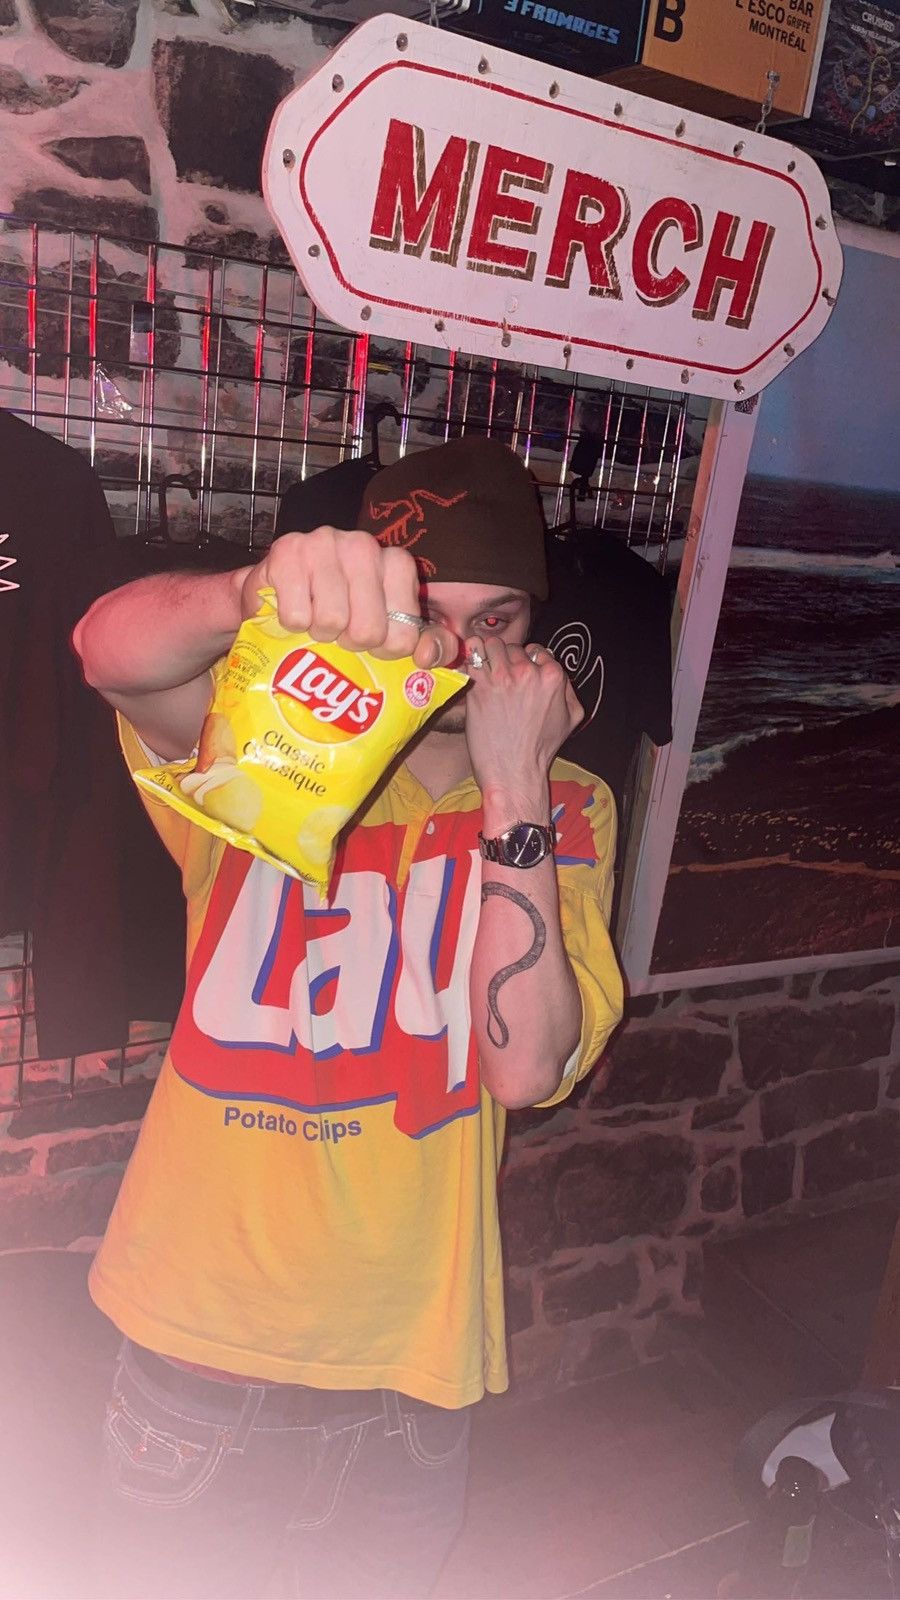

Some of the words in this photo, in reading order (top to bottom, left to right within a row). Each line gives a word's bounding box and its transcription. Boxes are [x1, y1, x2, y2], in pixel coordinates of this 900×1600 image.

[520, 0, 621, 44] FROMAGES
[653, 0, 686, 42] B
[787, 14, 811, 33] GRIFFE
[789, 0, 814, 17] BAR
[750, 18, 807, 52] MONTRÉAL
[369, 118, 776, 330] MERCH
[277, 650, 379, 723] Lay's
[242, 741, 327, 797] Clasique
[263, 730, 326, 774] Classic
[224, 1106, 298, 1136] Potato
